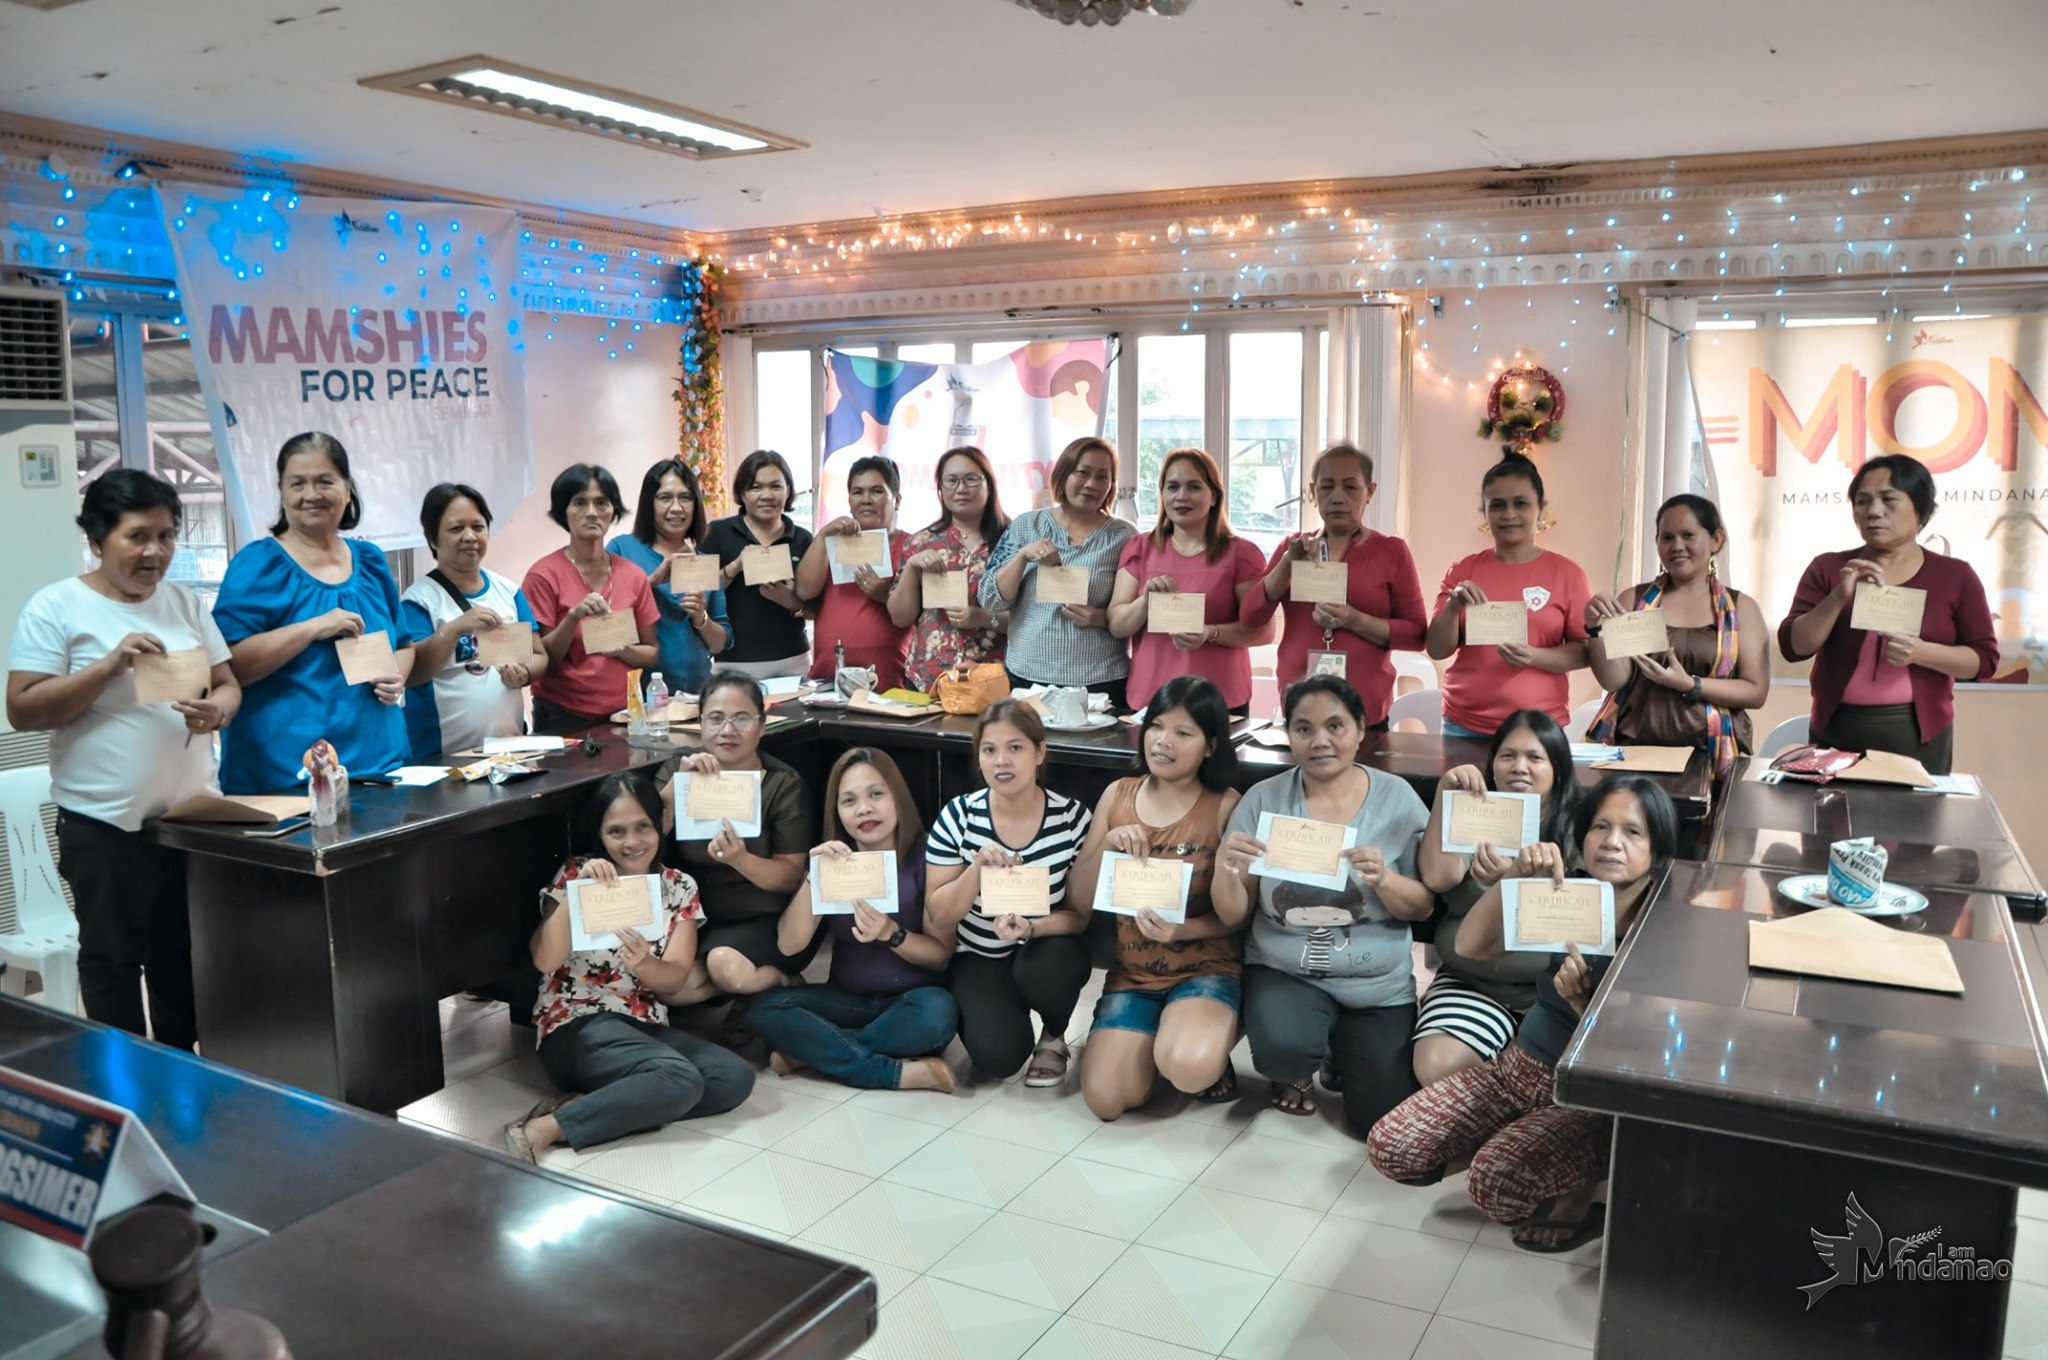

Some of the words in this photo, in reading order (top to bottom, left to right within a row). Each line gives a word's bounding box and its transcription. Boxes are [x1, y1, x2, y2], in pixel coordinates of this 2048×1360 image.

[208, 304, 488, 364] MAMSHIES
[301, 369, 375, 403] FOR
[387, 367, 490, 400] PEACE
[1782, 491, 1852, 504] MAMS
[1347, 951, 1373, 968] Ice
